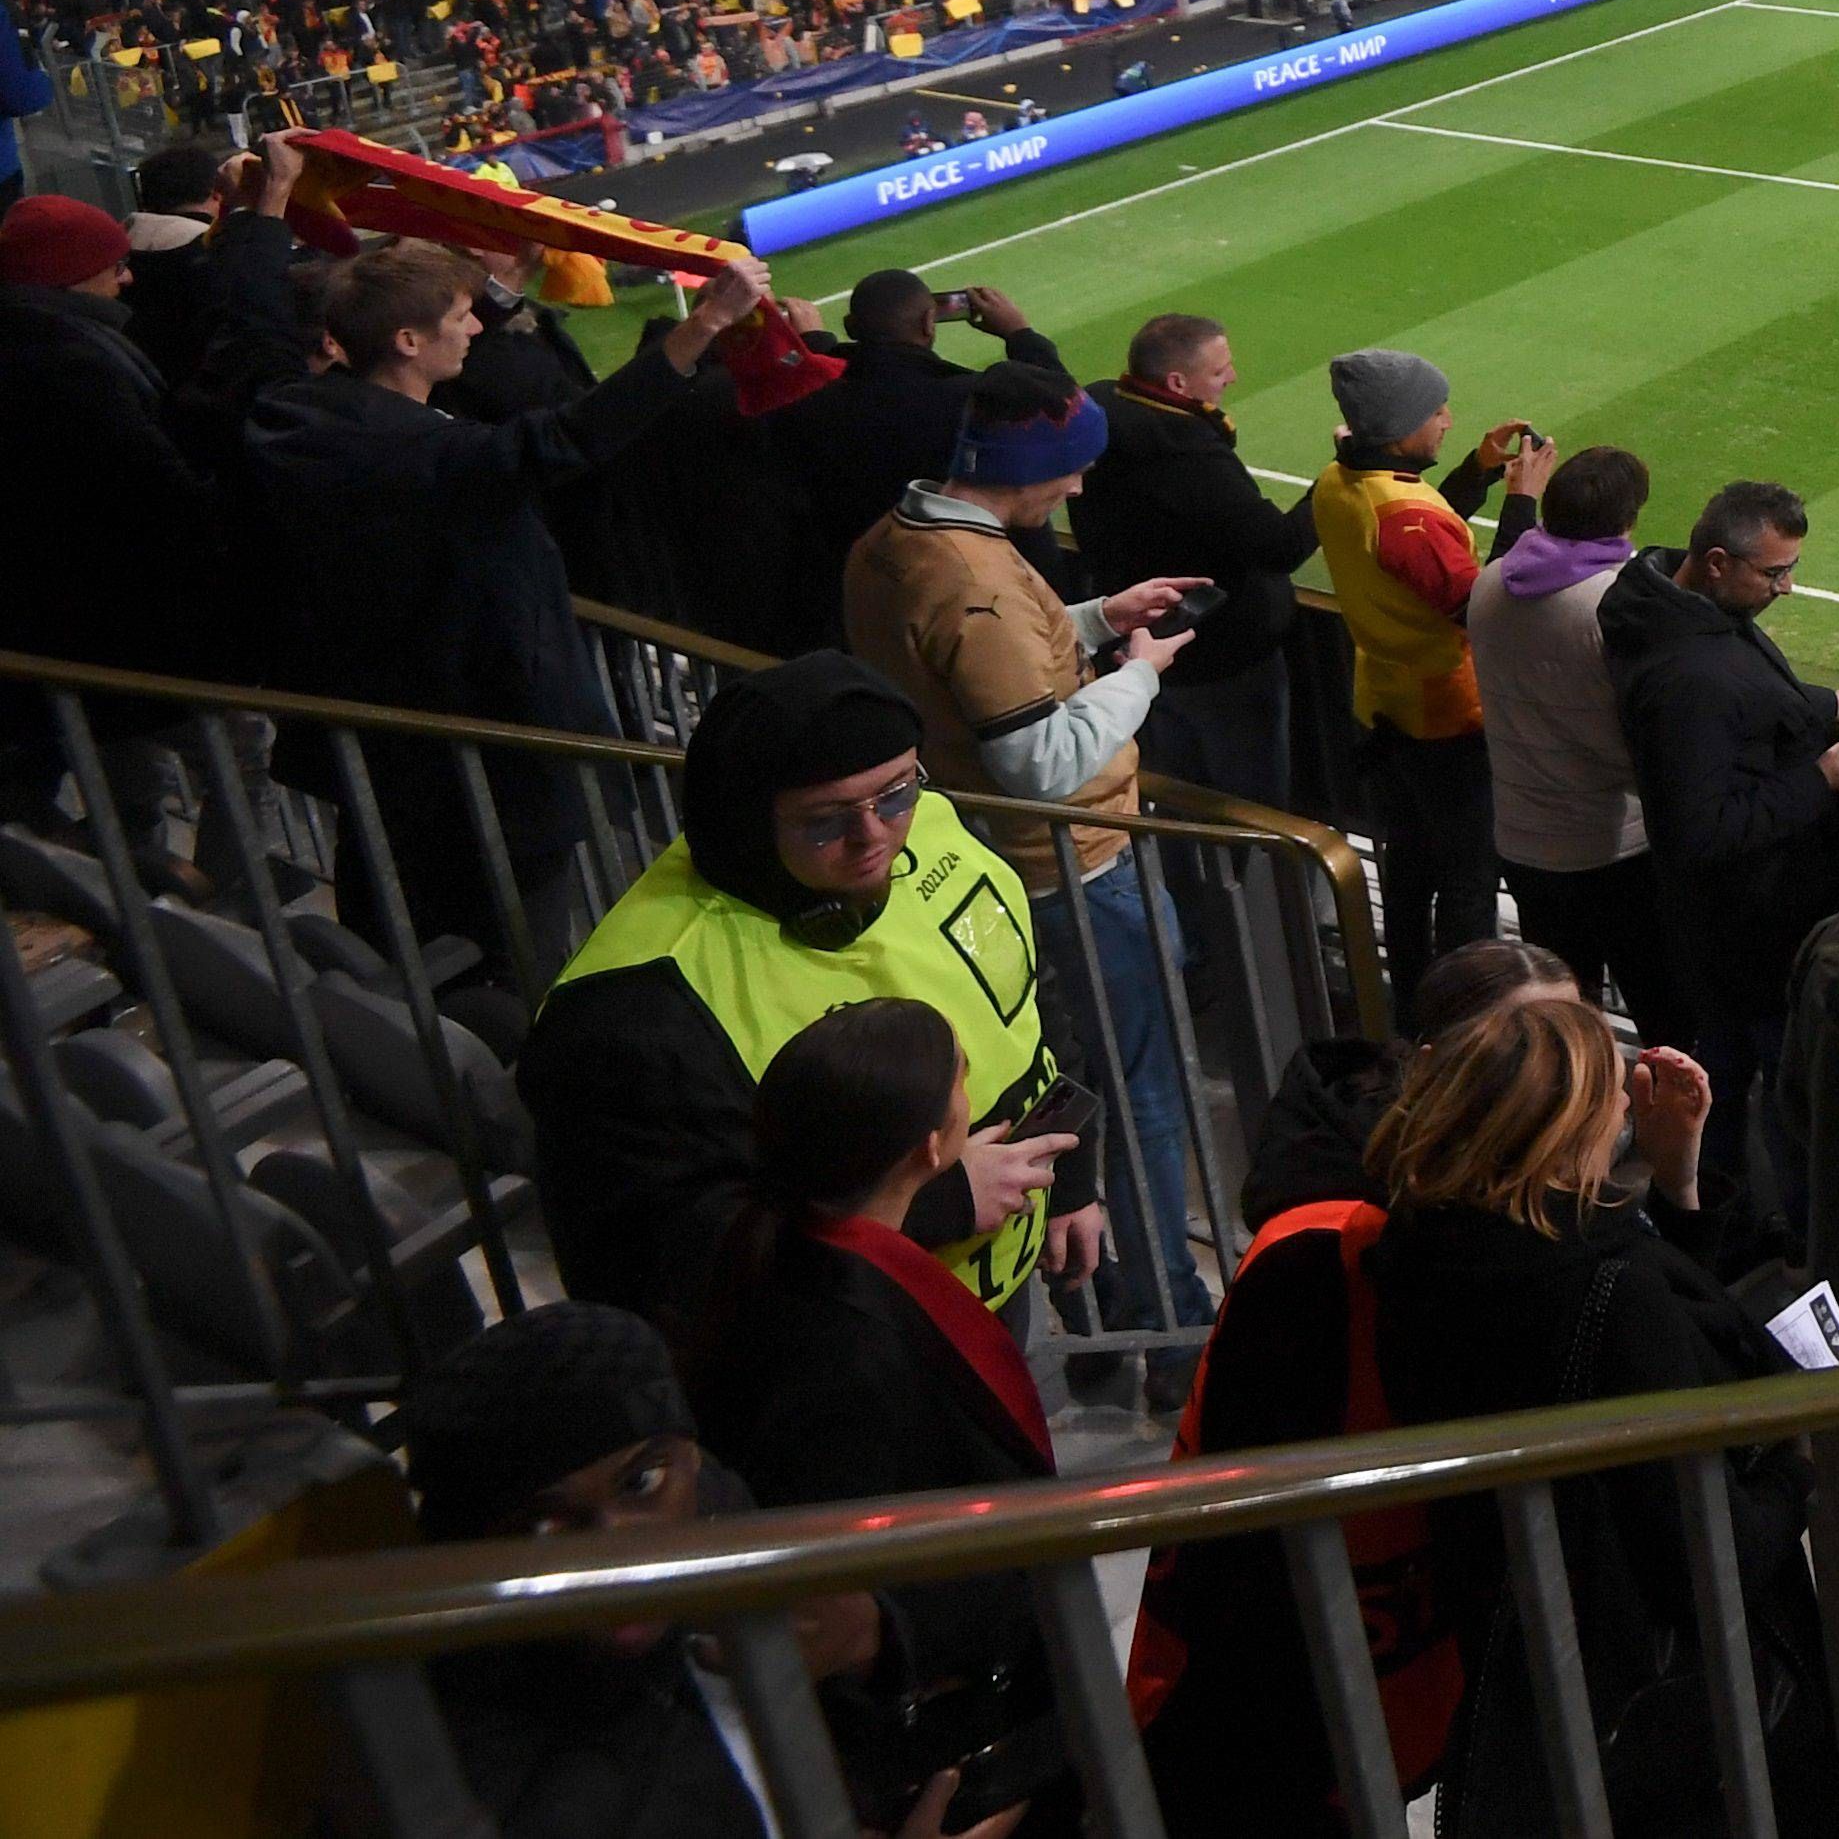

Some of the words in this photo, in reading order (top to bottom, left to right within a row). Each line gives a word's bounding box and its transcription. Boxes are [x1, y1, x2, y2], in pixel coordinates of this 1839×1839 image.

[1253, 54, 1322, 91] PEACE
[876, 158, 964, 206] PEACE
[915, 851, 962, 902] 2021/24
